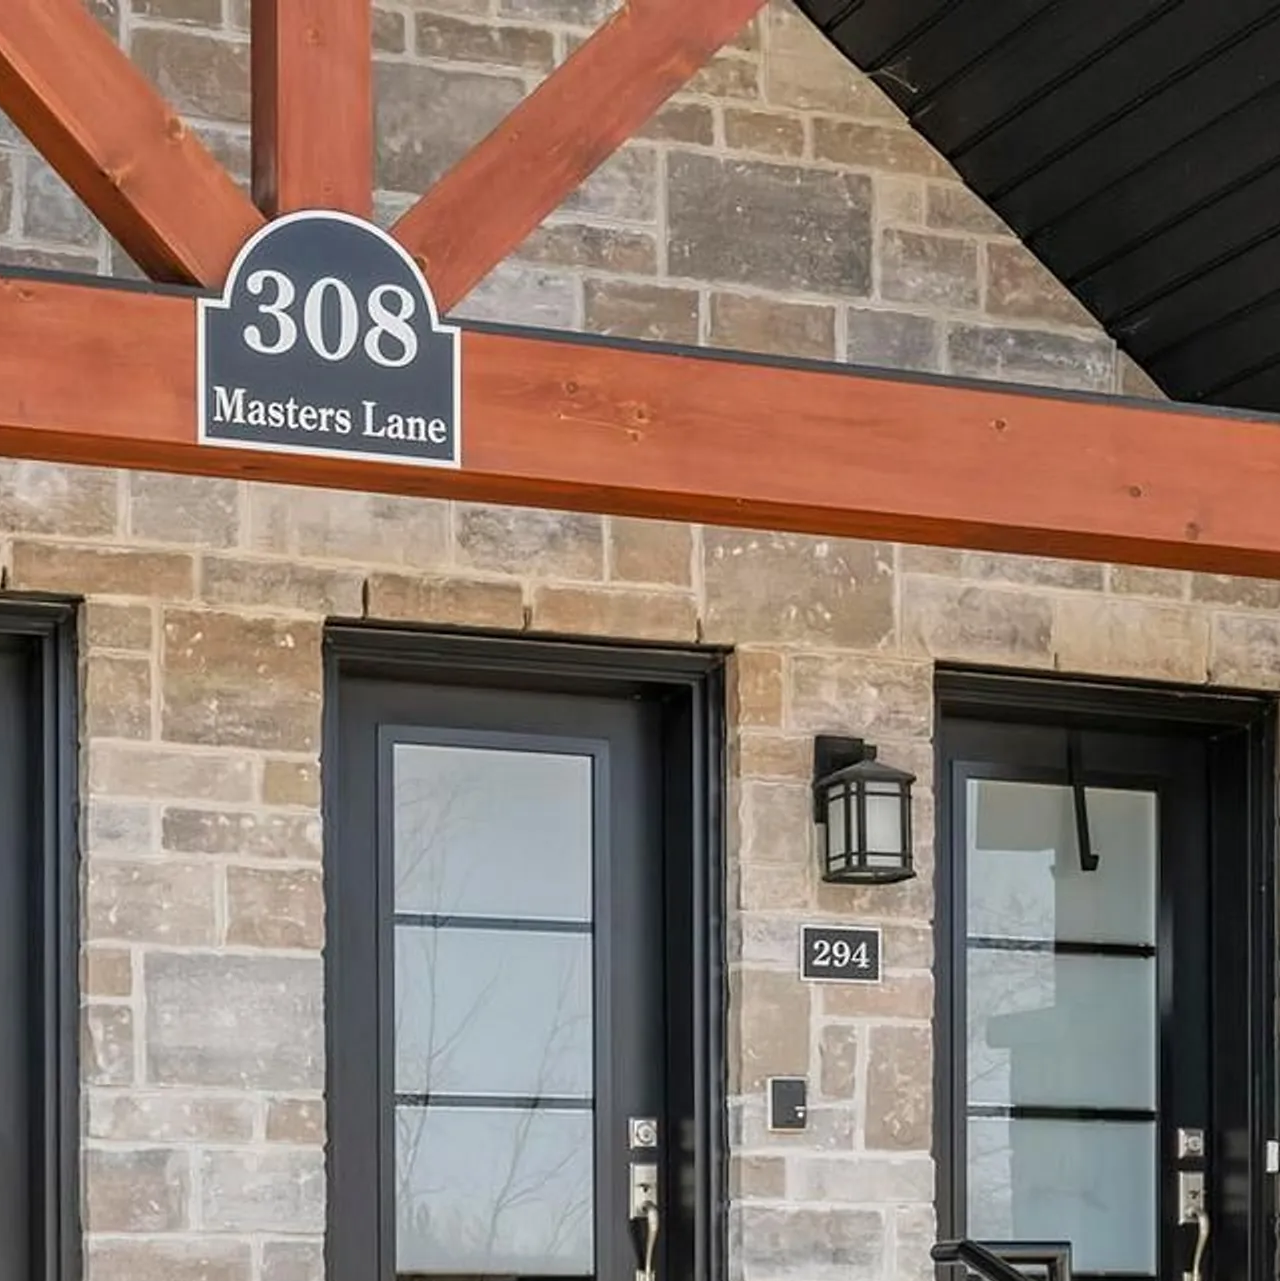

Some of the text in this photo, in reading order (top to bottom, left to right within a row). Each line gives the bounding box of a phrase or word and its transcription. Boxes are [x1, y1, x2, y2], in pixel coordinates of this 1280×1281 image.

[243, 269, 418, 368] 308
[213, 386, 447, 443] Masters Lane
[812, 940, 870, 968] 294
